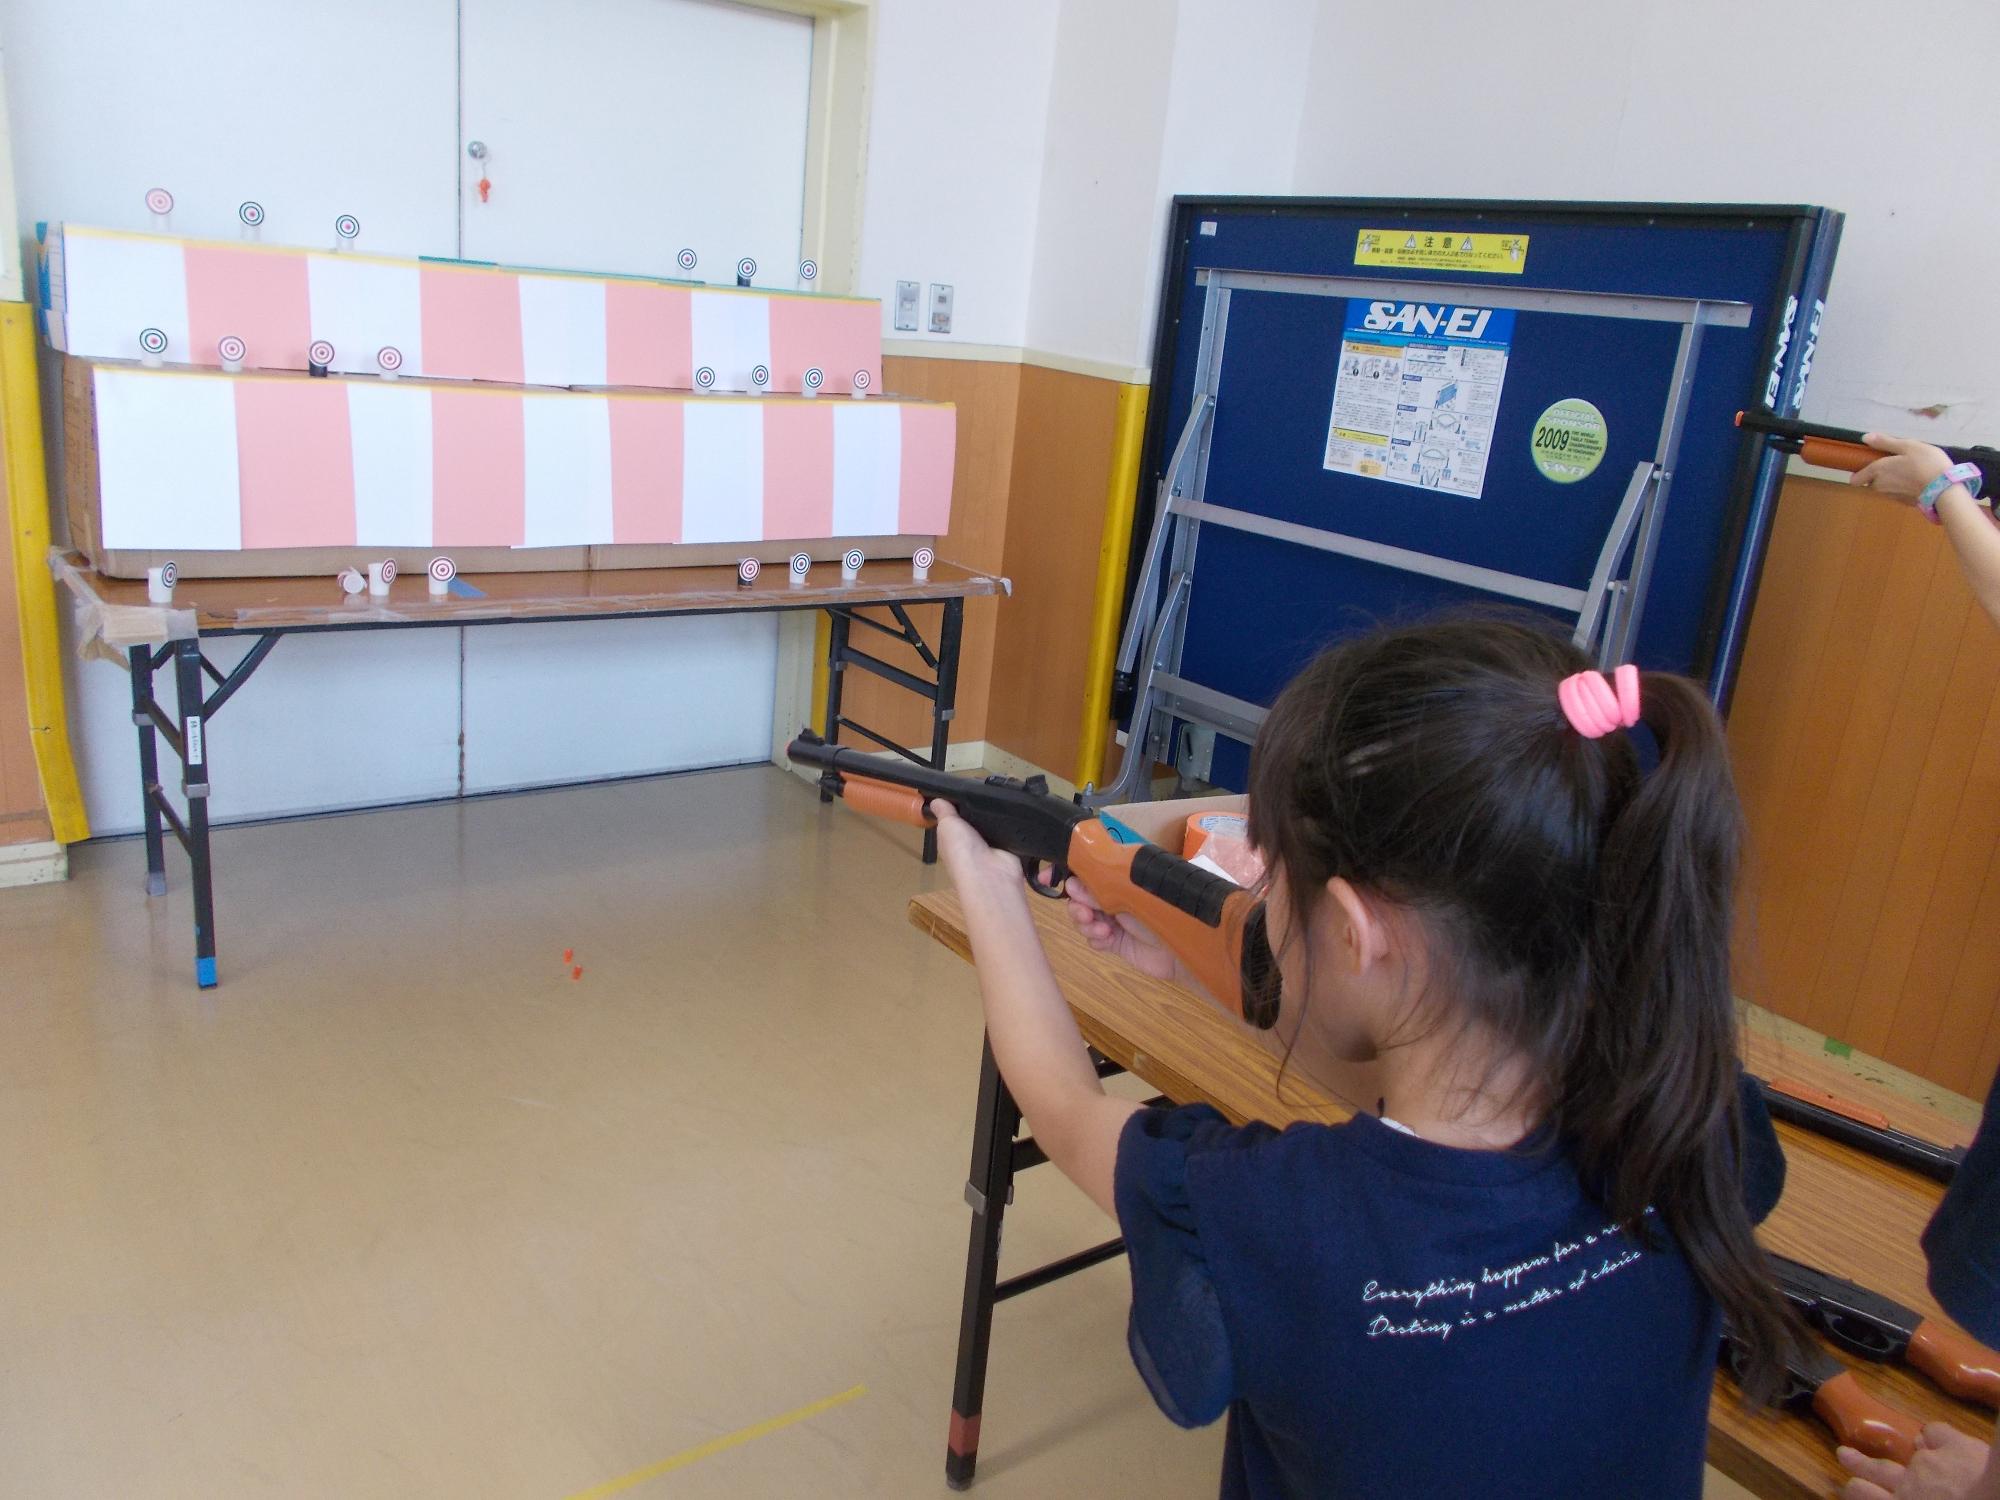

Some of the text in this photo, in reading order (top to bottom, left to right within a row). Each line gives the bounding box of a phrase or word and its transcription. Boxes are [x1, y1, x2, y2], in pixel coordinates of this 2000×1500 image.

[1363, 301, 1493, 339] SAN-EI
[1535, 426, 1570, 451] 2009
[1362, 1278, 1476, 1308] Everything
[1481, 1256, 1550, 1289] happens
[1554, 1242, 1580, 1262] for
[1584, 1234, 1598, 1244] a
[1366, 1251, 1643, 1340] Destiny is a matter of choice
